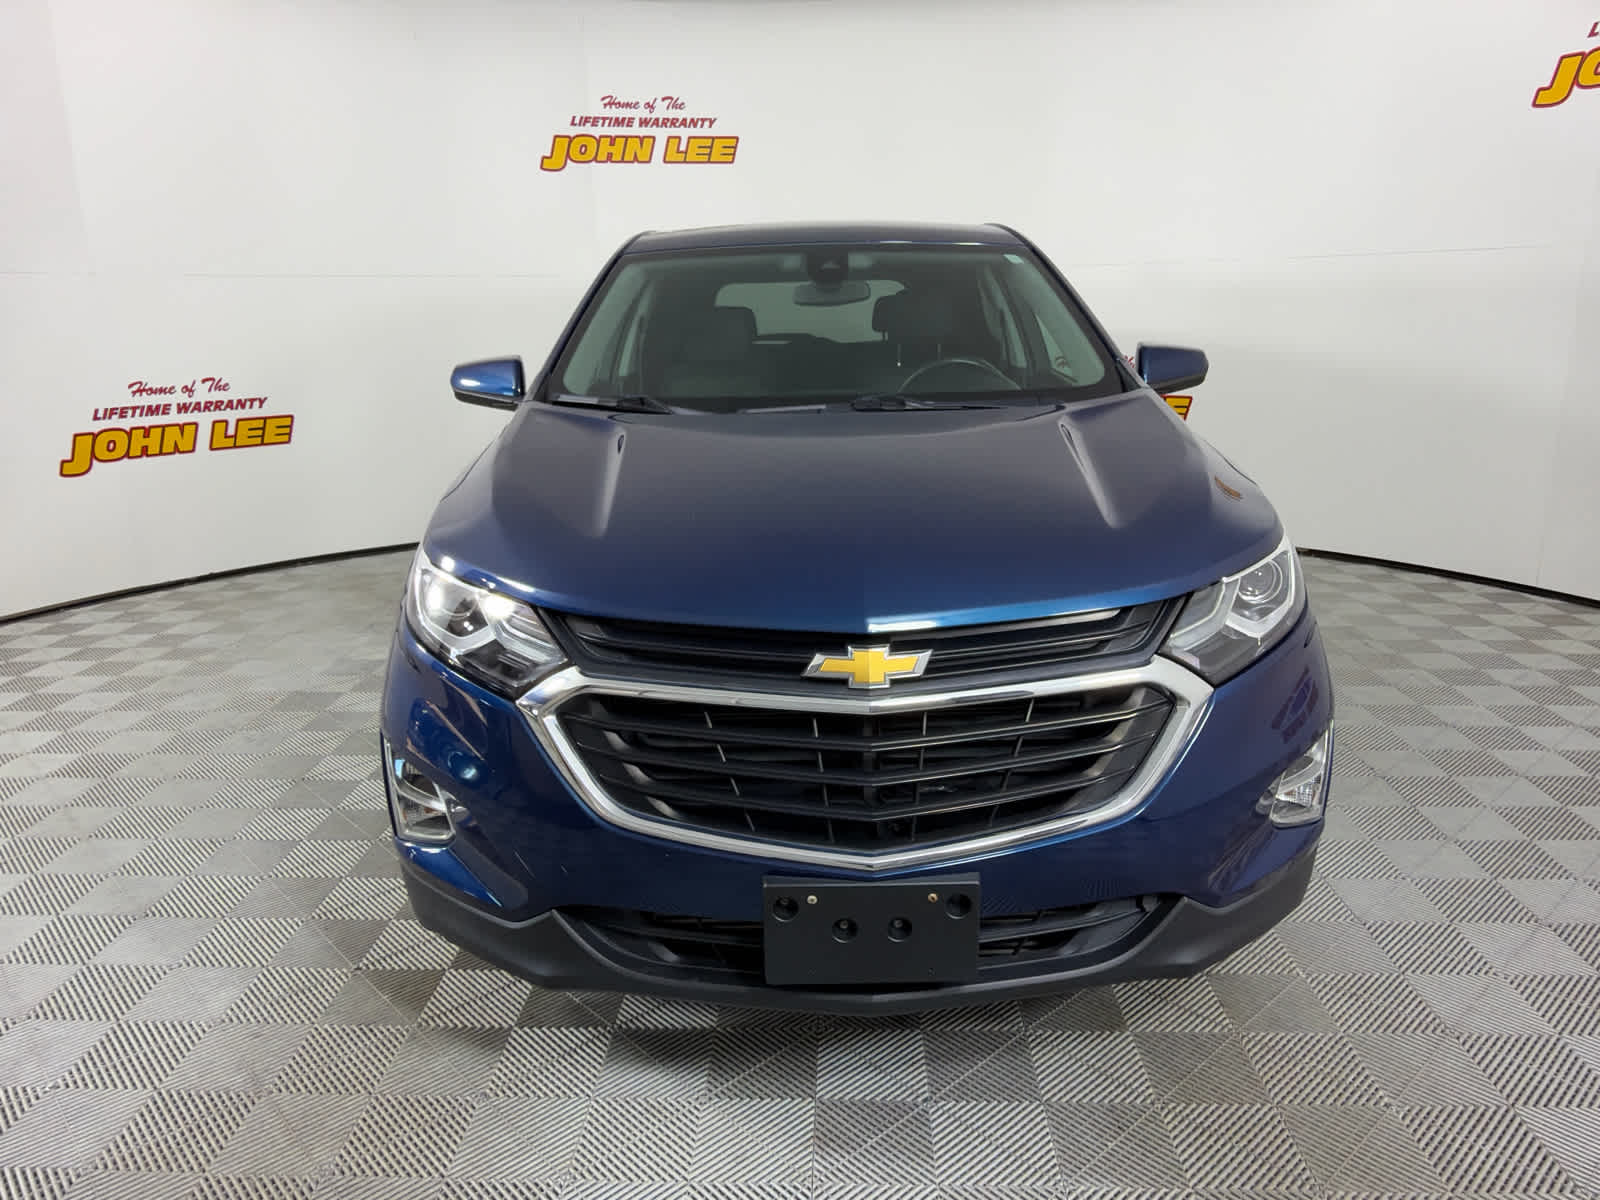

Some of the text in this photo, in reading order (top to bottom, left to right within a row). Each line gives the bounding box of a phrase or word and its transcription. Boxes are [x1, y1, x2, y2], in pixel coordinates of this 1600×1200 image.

[601, 95, 686, 114] Home of The
[570, 115, 717, 129] LIFETIME WARRANTY
[540, 133, 739, 172] JOHN LEE
[127, 376, 231, 399] Home of The
[92, 396, 268, 421] LIFETIME WARRANTY
[59, 414, 294, 478] JOHN LEE
